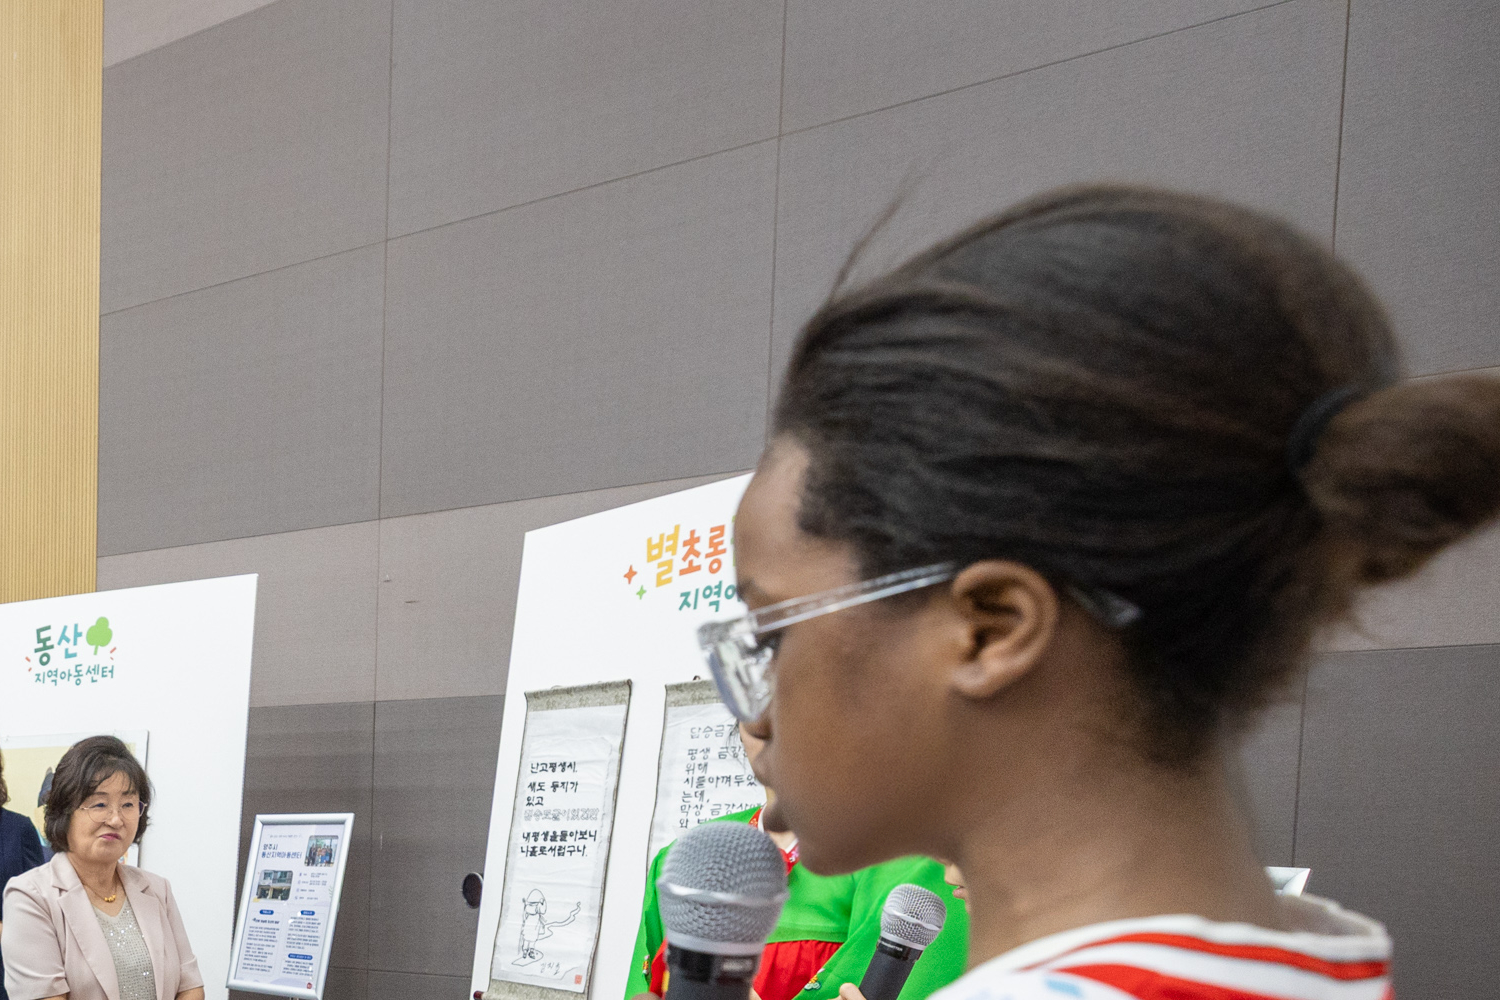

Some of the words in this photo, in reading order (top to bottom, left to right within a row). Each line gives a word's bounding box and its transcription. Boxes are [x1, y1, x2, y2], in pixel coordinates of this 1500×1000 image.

[647, 516, 737, 588] 별초롱
[34, 623, 83, 666] 동산
[35, 663, 114, 686] 지역아동센터
[688, 747, 710, 760] 평생
[718, 745, 747, 759] 금강
[685, 762, 708, 774] 위해
[527, 781, 545, 792] 새도
[550, 780, 578, 792] 둥지가
[526, 795, 544, 806] 있고
[682, 790, 709, 803] 는데,
[680, 803, 703, 816] 막상
[261, 851, 302, 859] 동산지역아동센터
